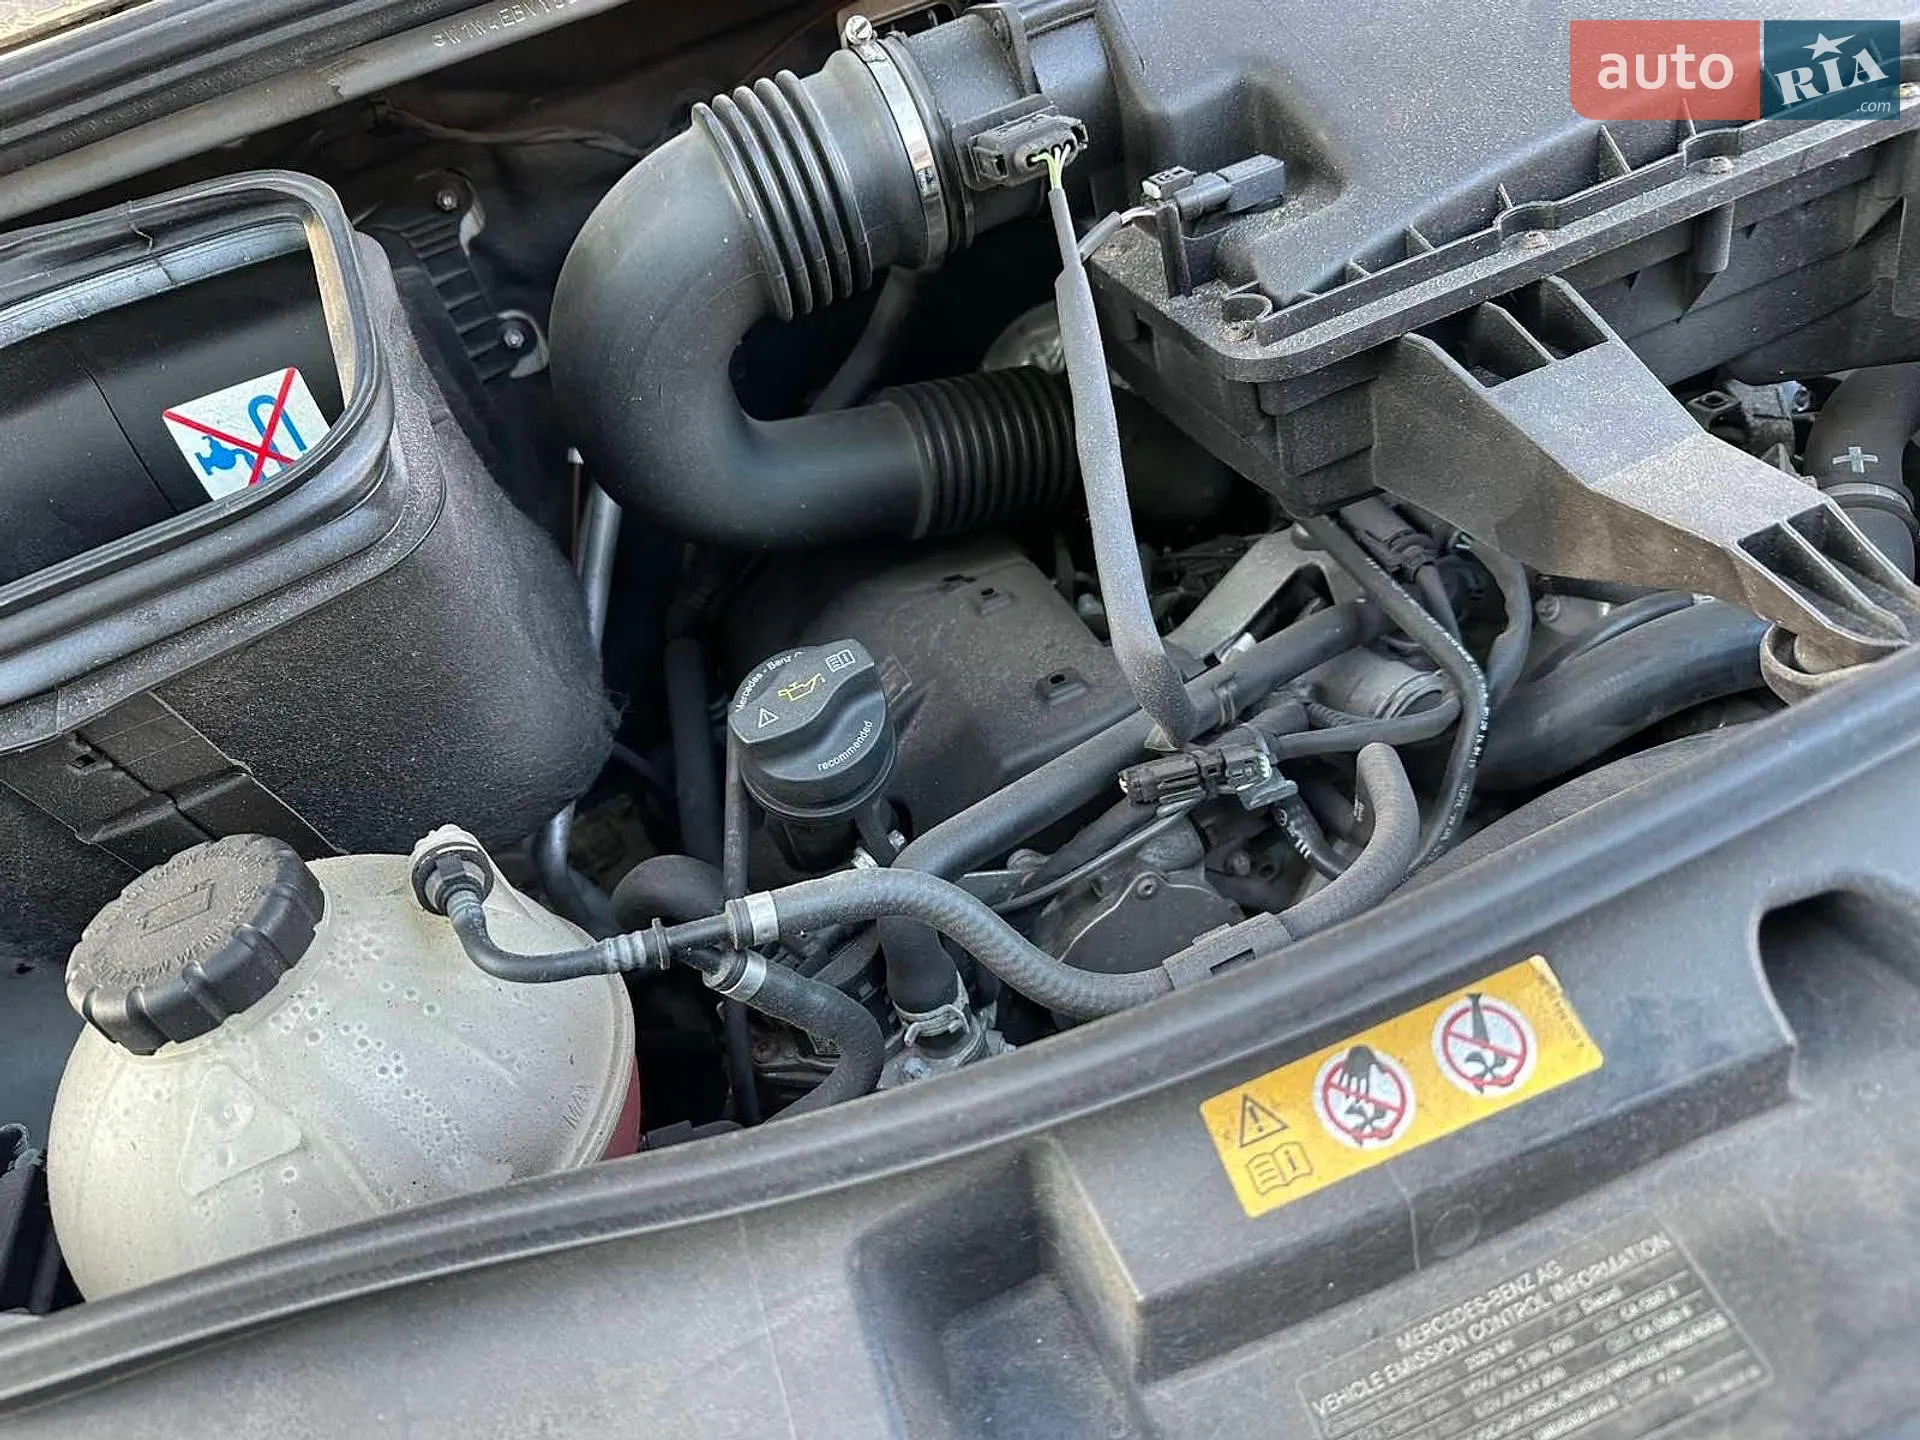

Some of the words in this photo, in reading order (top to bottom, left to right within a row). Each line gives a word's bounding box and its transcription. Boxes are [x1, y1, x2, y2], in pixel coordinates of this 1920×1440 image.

[817, 719, 873, 772] recommended
[1311, 1367, 1388, 1419] VEHICLE
[1385, 1333, 1470, 1382] EMISSION
[1467, 1293, 1553, 1345] CONTROL
[1548, 1236, 1672, 1302] INFORMATION
[1396, 1271, 1537, 1352] MERCEDES-BENZ
[1535, 1258, 1566, 1288] AG
